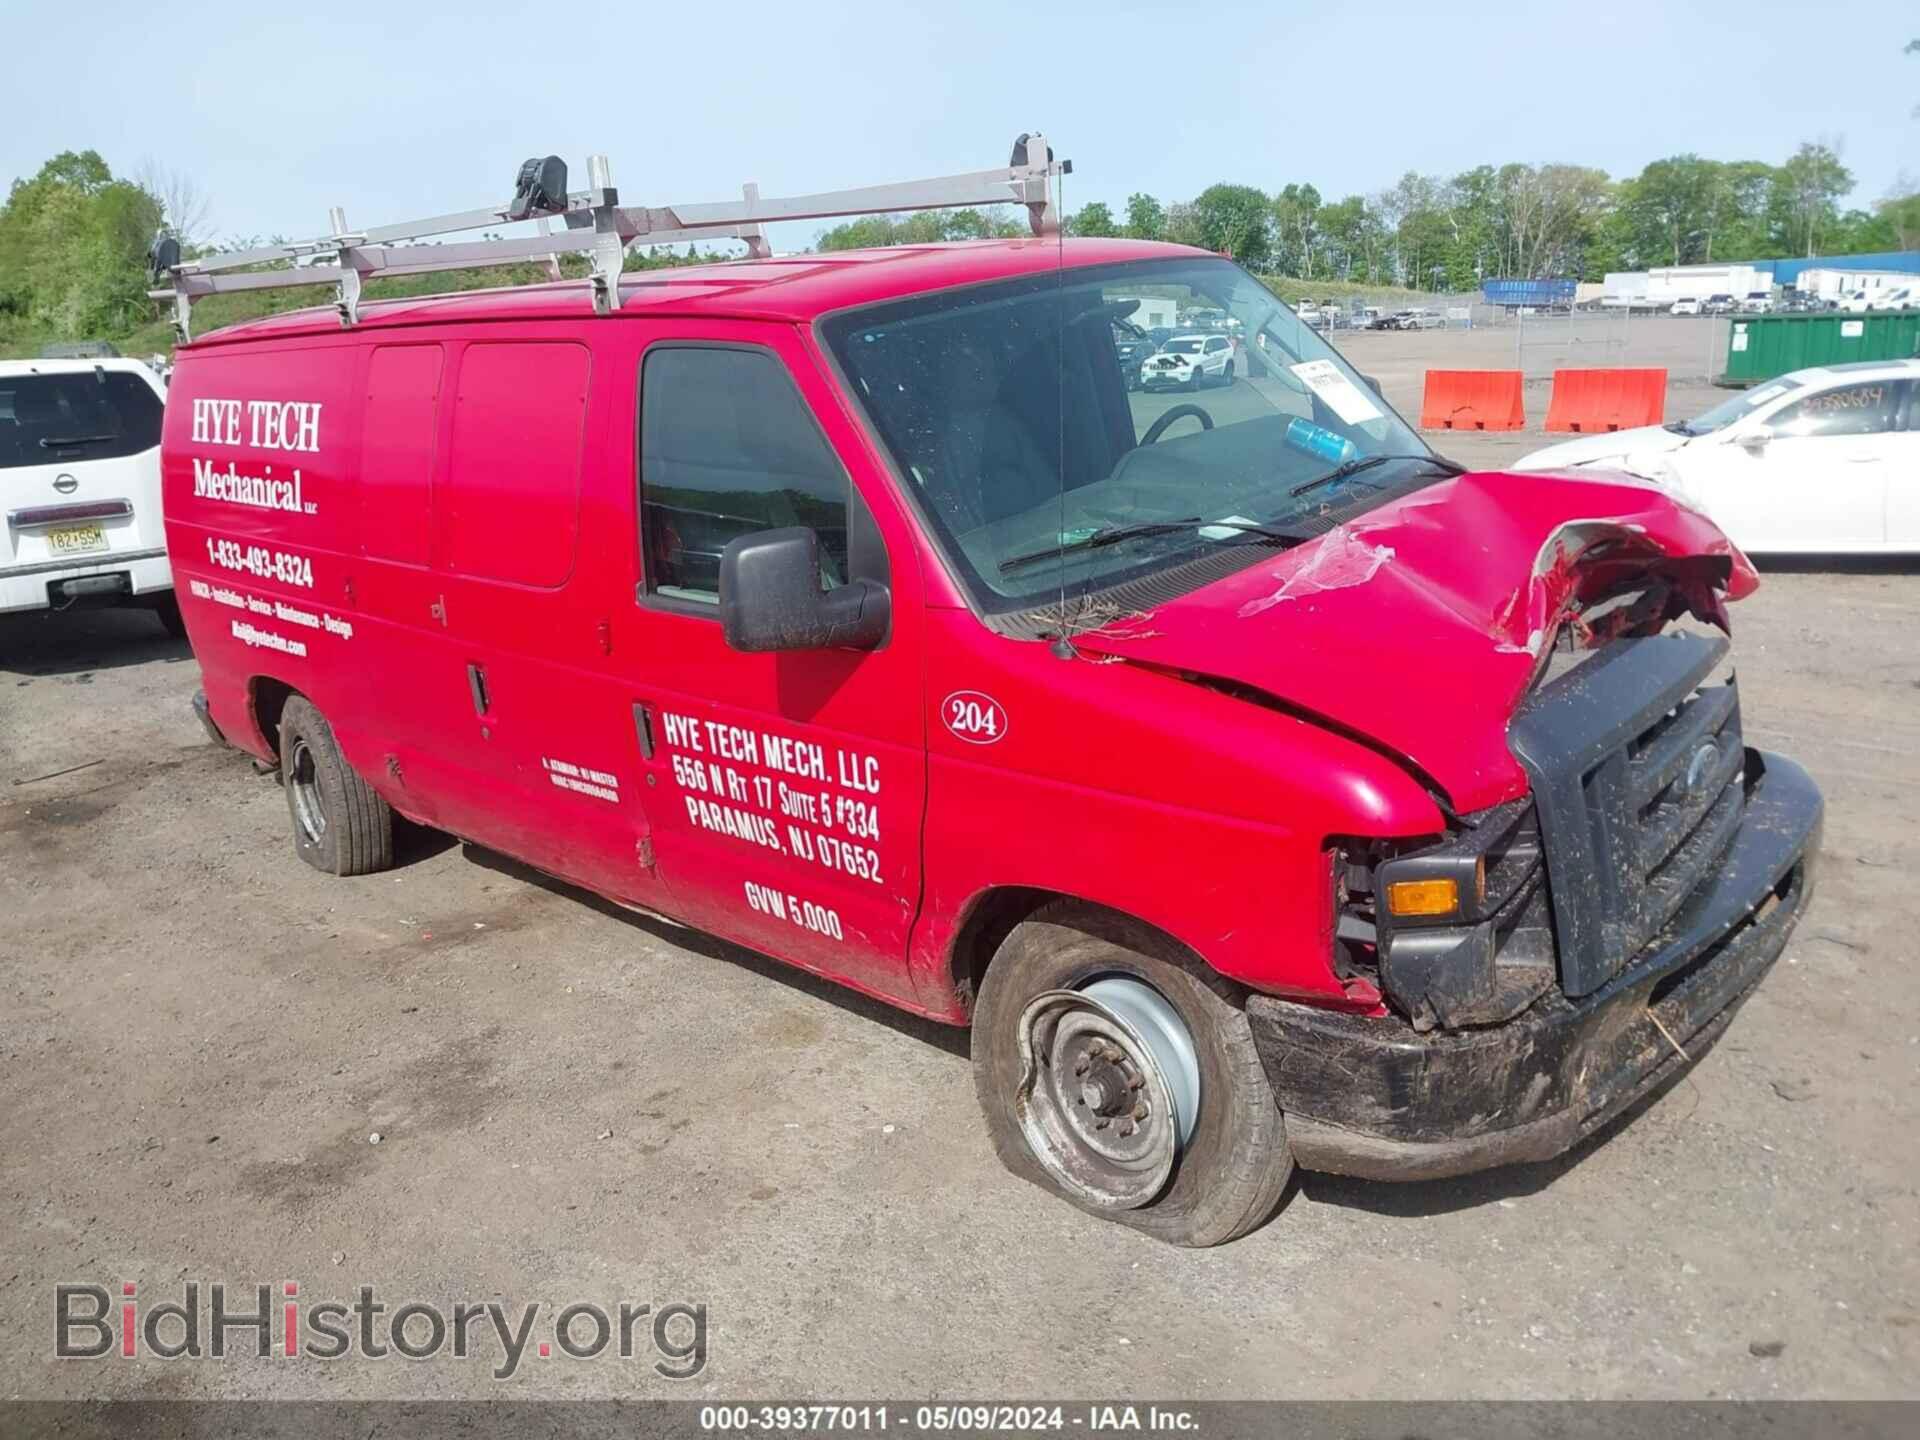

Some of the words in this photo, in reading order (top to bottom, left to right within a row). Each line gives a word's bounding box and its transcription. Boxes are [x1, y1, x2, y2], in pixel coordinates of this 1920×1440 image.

[192, 399, 242, 446] HYE
[248, 400, 322, 452] TECH
[192, 458, 303, 512] Mechanical
[206, 537, 314, 588] 1-833-493-8324
[952, 699, 997, 736] 204
[663, 712, 703, 751] HYE
[704, 721, 759, 765] TECH
[763, 734, 832, 783] MECH.
[838, 750, 880, 794] LLC
[672, 755, 708, 792] 556
[709, 765, 725, 798] N
[753, 775, 772, 811] 17
[821, 792, 833, 828] 5
[835, 795, 880, 842] #334
[685, 795, 788, 855] PARAMUS,
[788, 825, 813, 862] NJ
[817, 833, 884, 884] 07652
[744, 880, 785, 921] GVW
